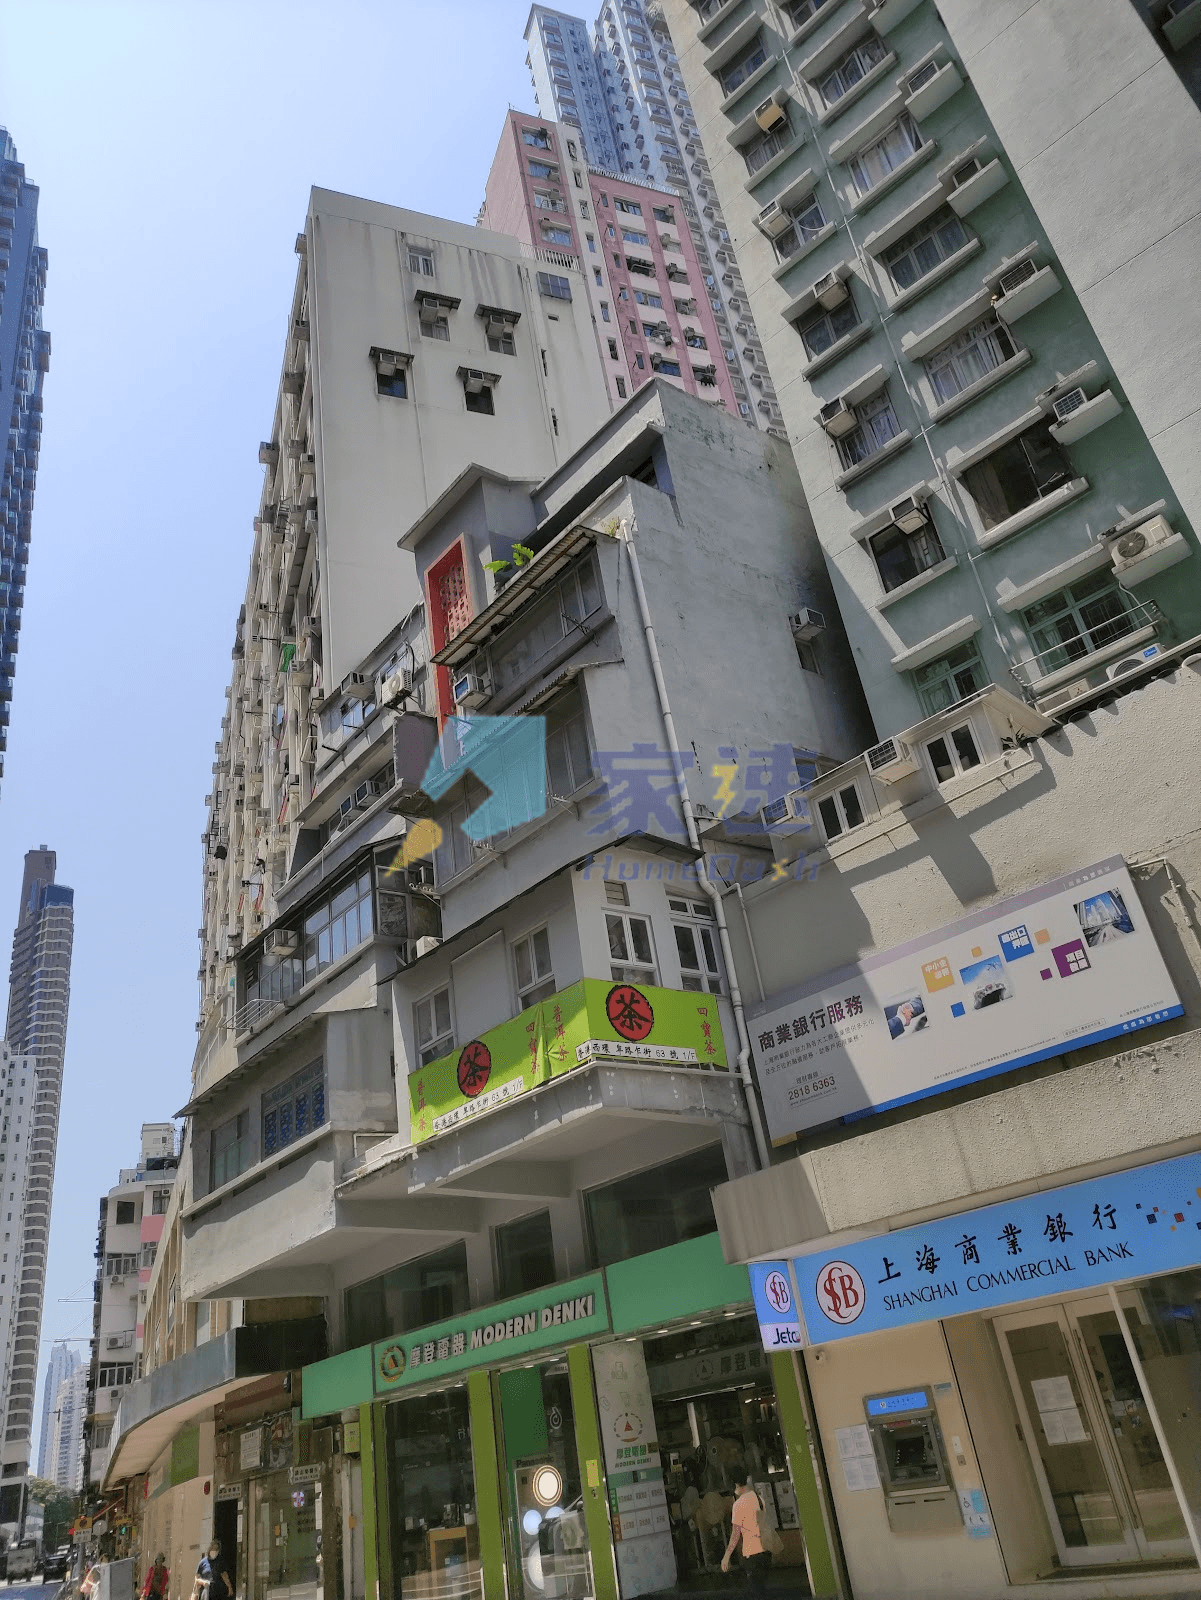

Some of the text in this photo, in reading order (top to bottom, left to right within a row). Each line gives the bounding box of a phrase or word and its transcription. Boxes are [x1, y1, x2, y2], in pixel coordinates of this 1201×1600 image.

[609, 992, 651, 1031] 茶
[758, 994, 866, 1053] 商業銀行服務
[459, 1046, 490, 1087] 茶
[655, 1048, 667, 1059] 63
[669, 1049, 679, 1060] 號
[683, 1050, 696, 1062] 1/F
[788, 1075, 836, 1102] 2818 6363
[877, 1202, 1118, 1285] 上海商業銀行
[883, 1241, 1135, 1312] SHANGHAI COMMERCIAL BANK
[409, 1294, 594, 1370] 摩登電器 MODERN DENKI
[720, 1351, 768, 1376] 摩登電
